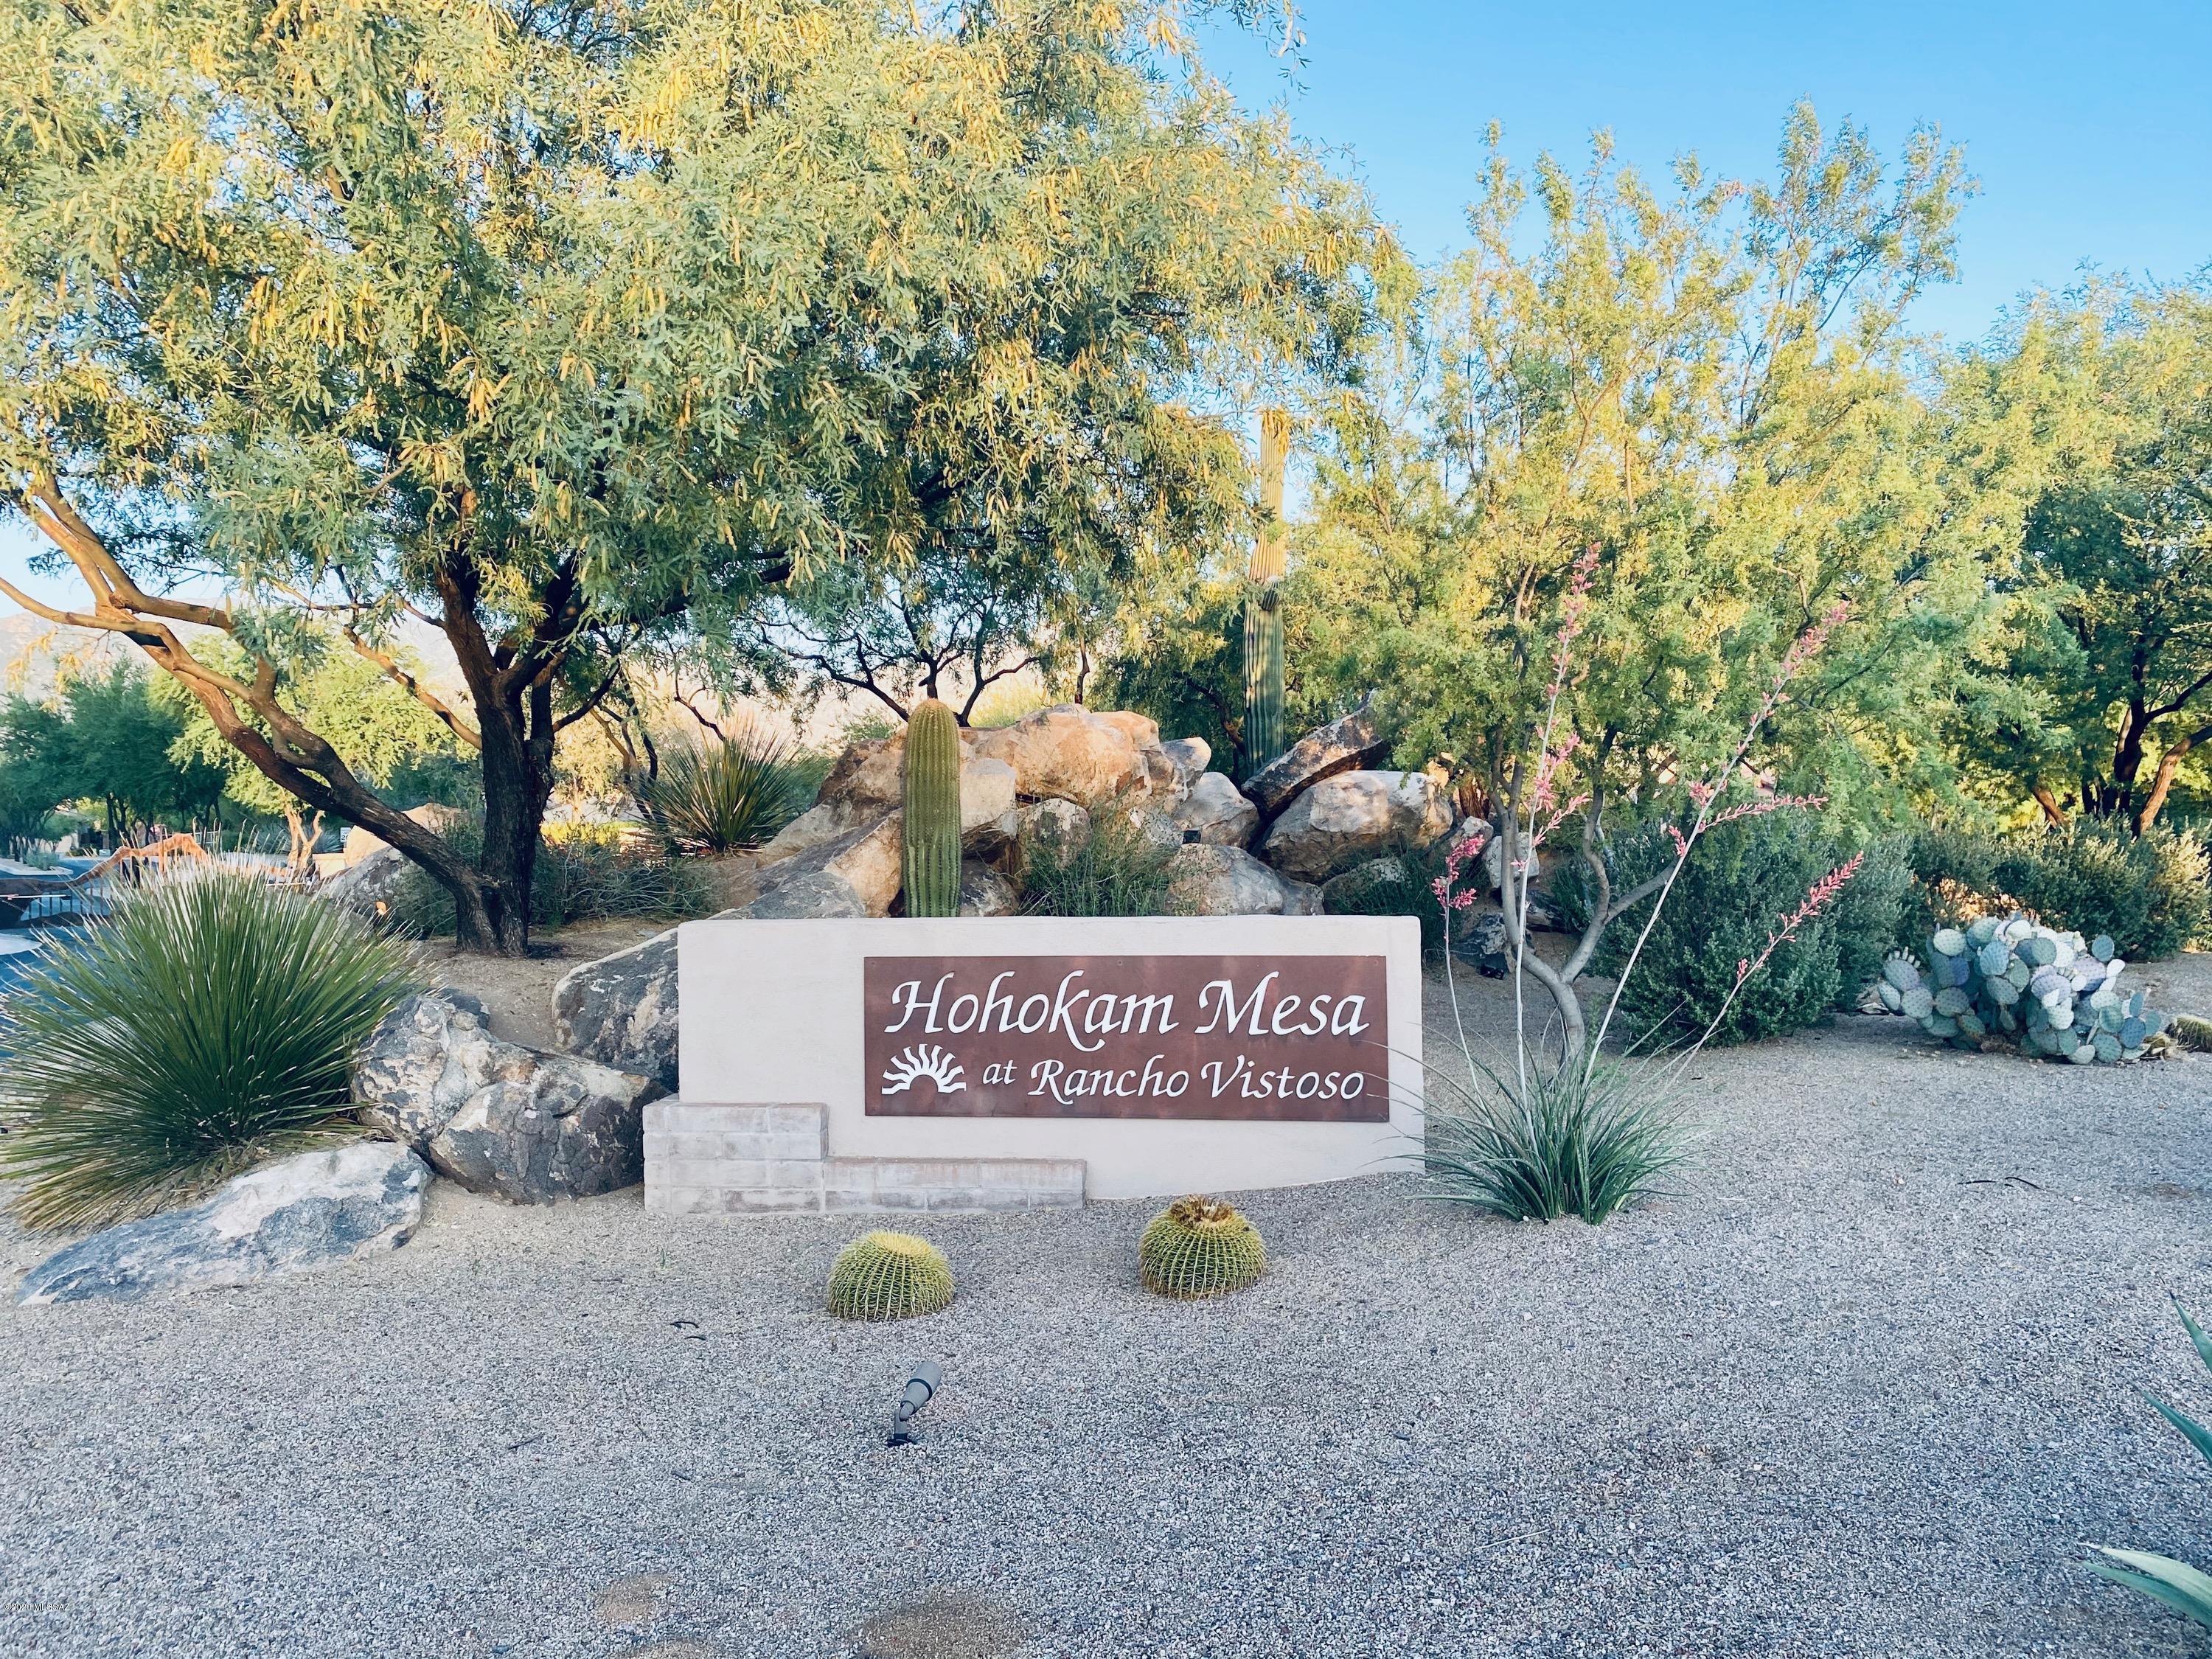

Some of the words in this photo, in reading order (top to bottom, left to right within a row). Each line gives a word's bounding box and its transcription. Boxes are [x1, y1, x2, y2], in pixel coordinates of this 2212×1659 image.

[884, 971, 1180, 1052] Hohokam
[1194, 970, 1370, 1036] Mesa
[982, 1060, 1018, 1085] at
[1028, 1054, 1189, 1105] Rancho
[1200, 1054, 1364, 1099] Vistoso
